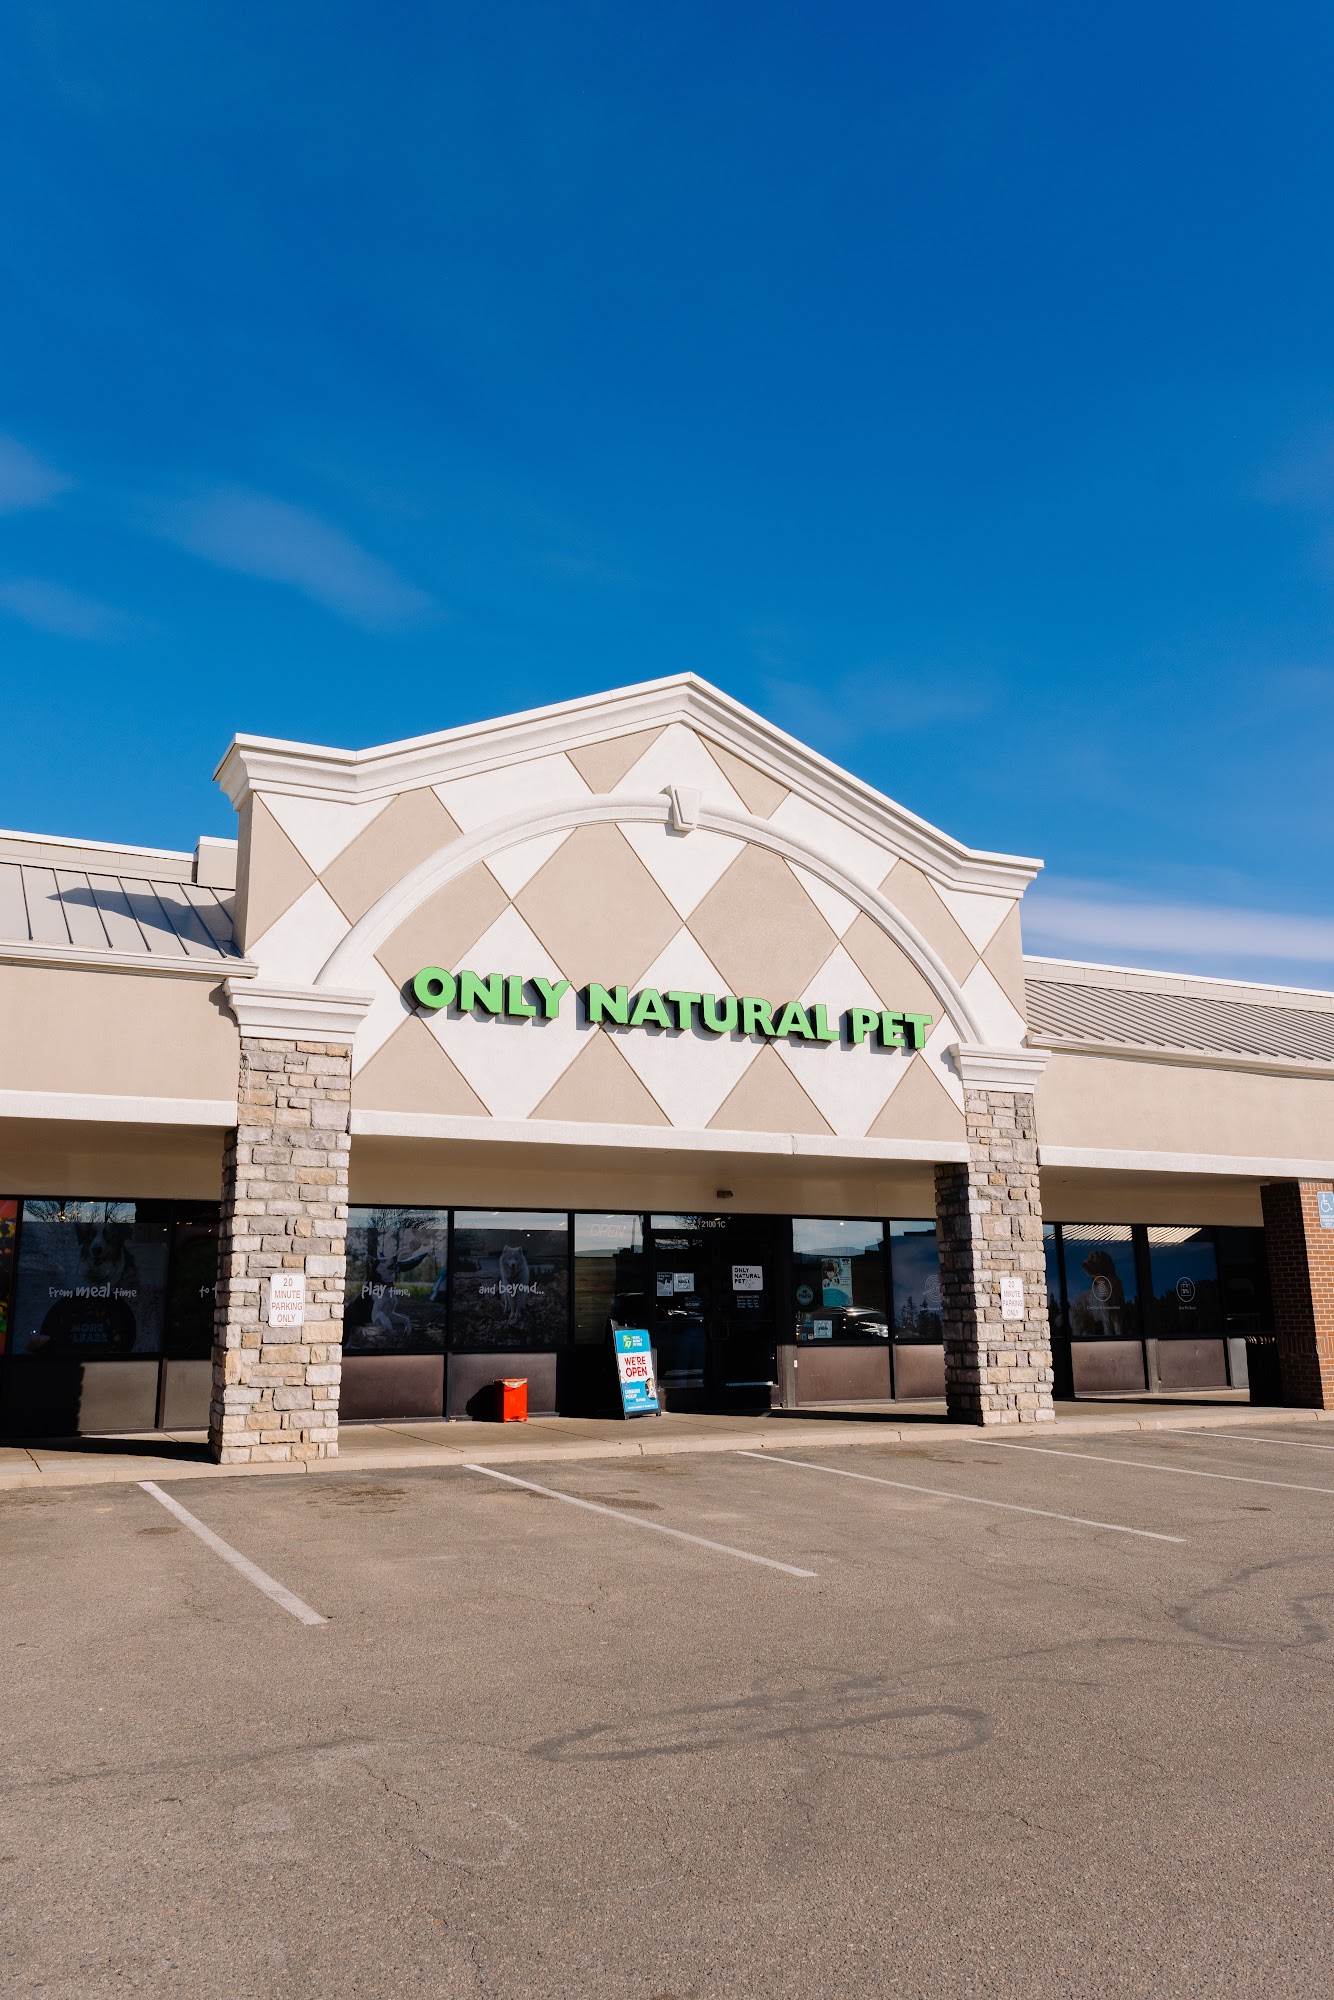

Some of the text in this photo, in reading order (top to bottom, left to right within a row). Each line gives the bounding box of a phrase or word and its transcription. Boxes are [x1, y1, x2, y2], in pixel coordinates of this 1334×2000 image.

[411, 966, 933, 1050] ONLY NATURAL PET
[701, 1220, 716, 1228] 2100
[591, 1223, 625, 1238] OPEN
[283, 1278, 293, 1287] 20
[49, 1282, 138, 1300] From meal time
[361, 1281, 411, 1299] play time,
[478, 1280, 545, 1298] and beyond...
[1003, 1290, 1021, 1298] MINUTE
[274, 1290, 301, 1299] MINUTE
[271, 1301, 303, 1311] PARKING
[1002, 1299, 1023, 1307] PARKING
[277, 1314, 296, 1323] ONLY
[624, 1356, 647, 1366] WE'RE
[625, 1366, 648, 1378] OPEN
